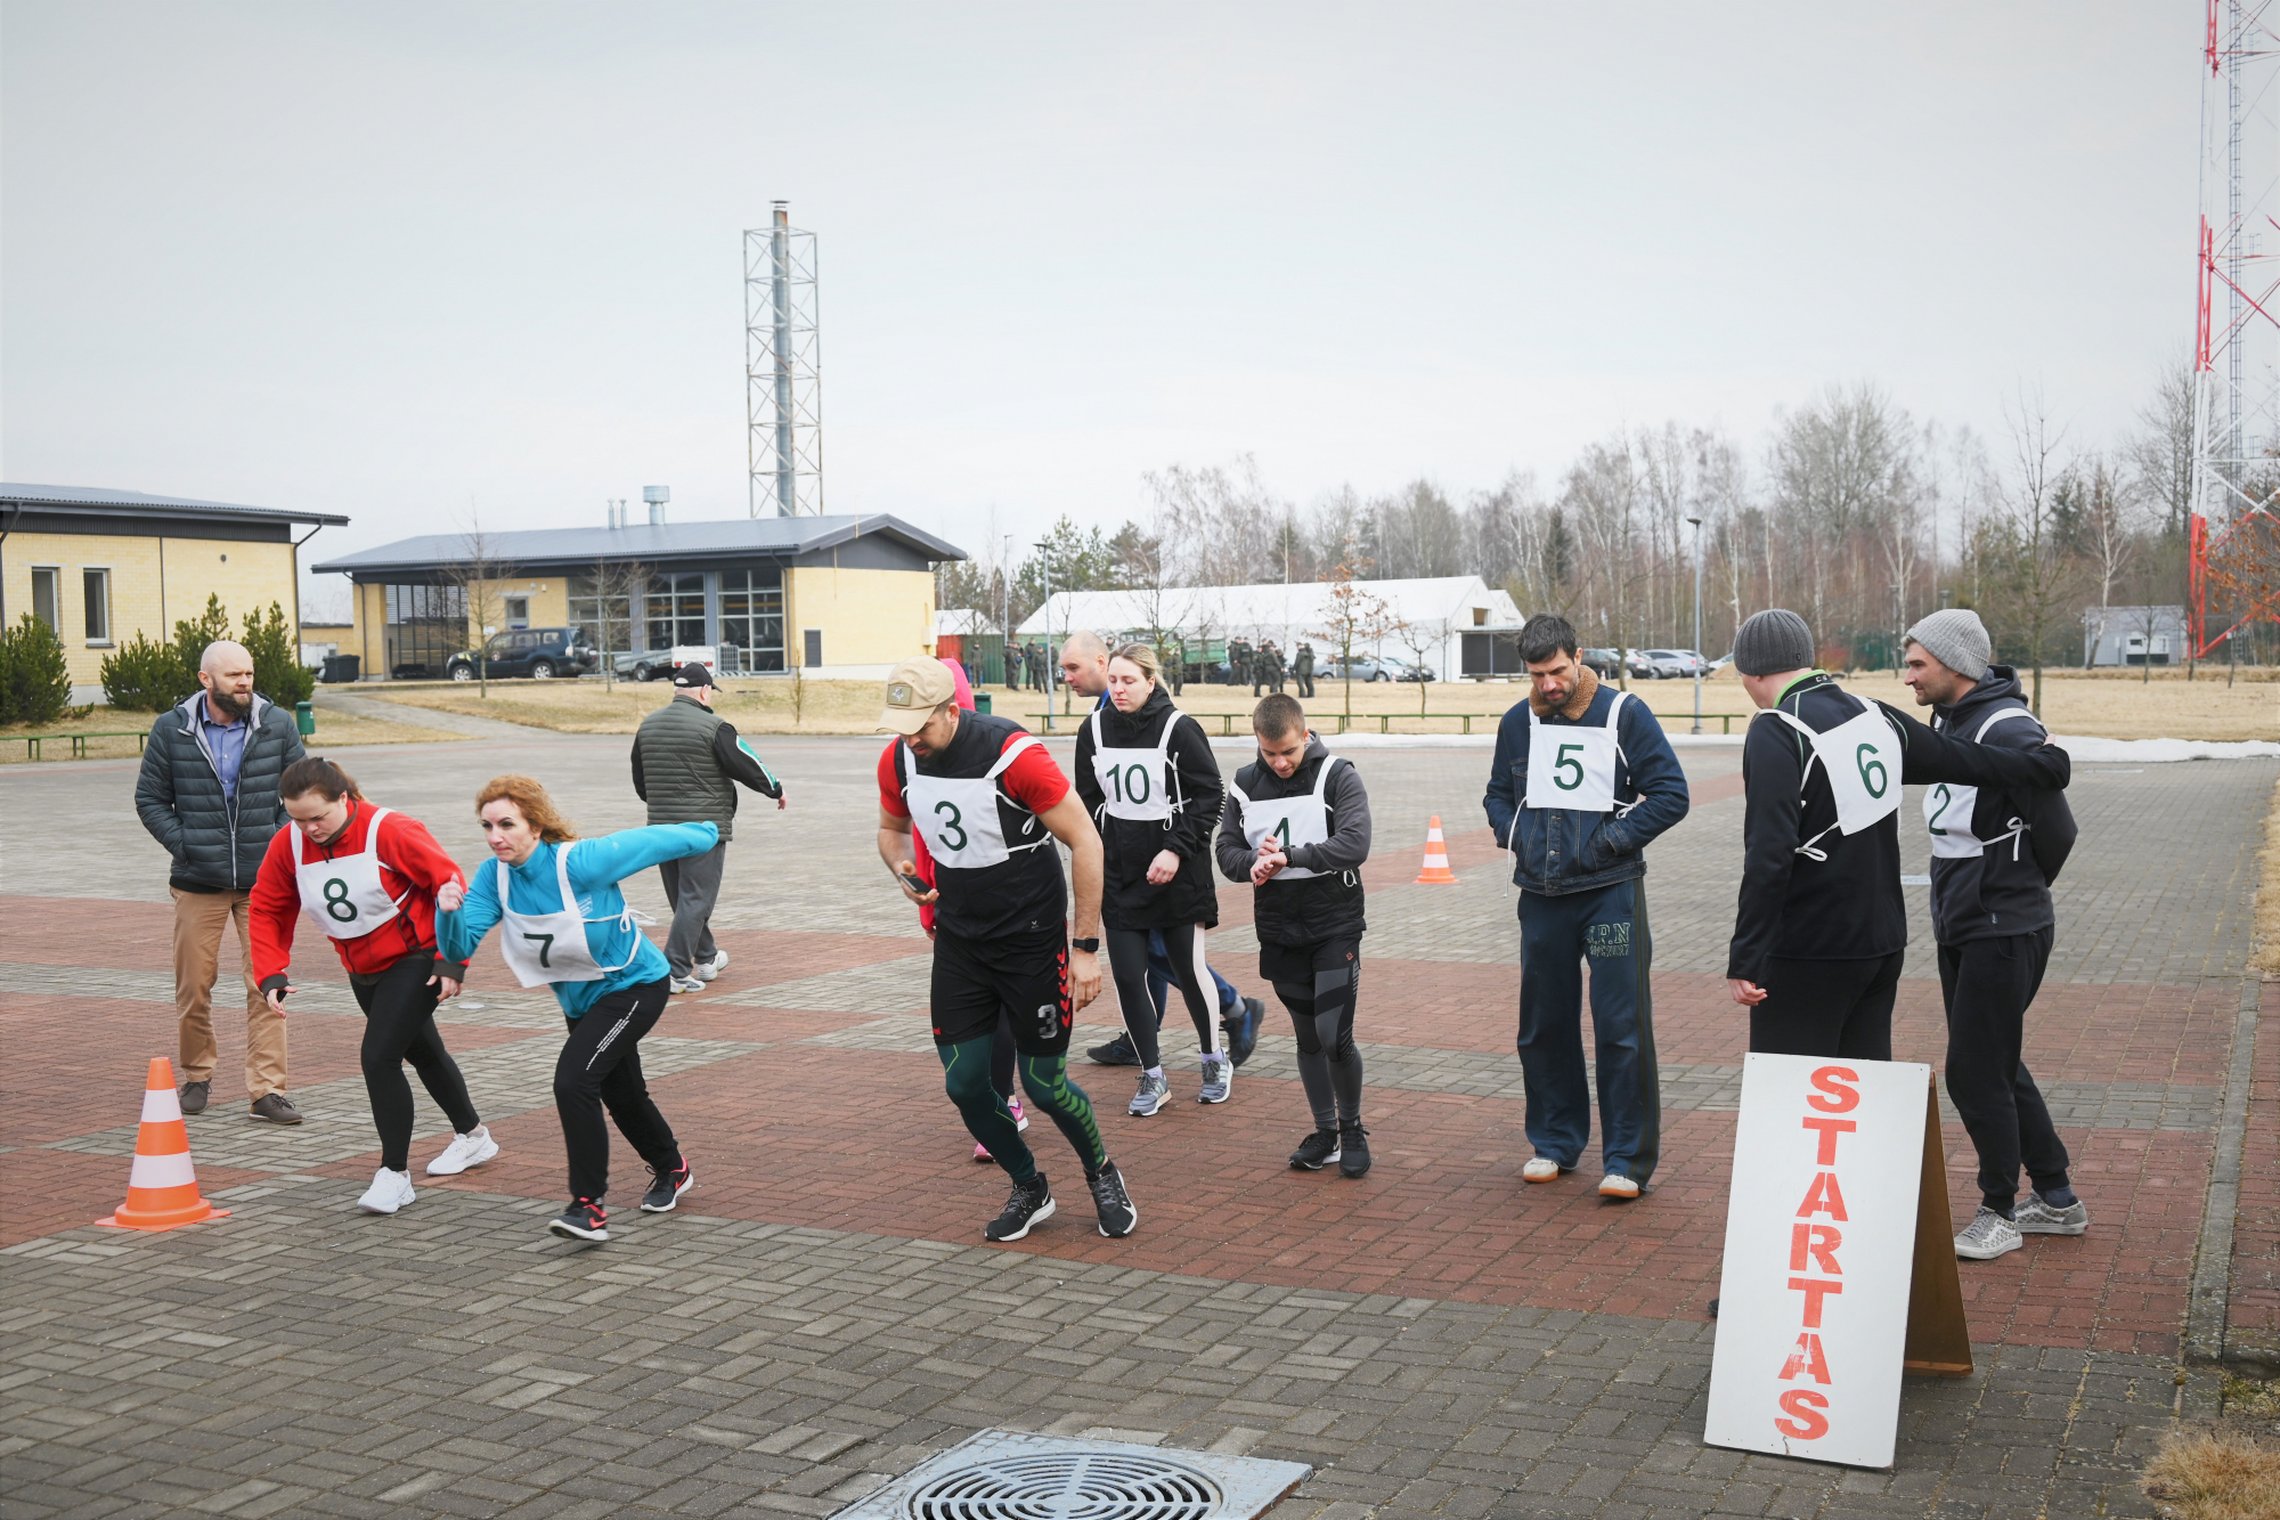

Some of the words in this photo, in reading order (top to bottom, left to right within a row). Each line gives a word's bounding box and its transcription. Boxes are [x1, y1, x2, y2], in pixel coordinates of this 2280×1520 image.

[1106, 763, 1150, 805] 10
[1553, 743, 1585, 791] 5
[1856, 743, 1889, 800] 6
[933, 800, 969, 853] 3
[1928, 783, 1951, 836] 2
[323, 877, 358, 923] 8
[523, 932, 555, 969] 7
[1037, 1003, 1058, 1039] 3
[1774, 1065, 1861, 1441] STARTAS
